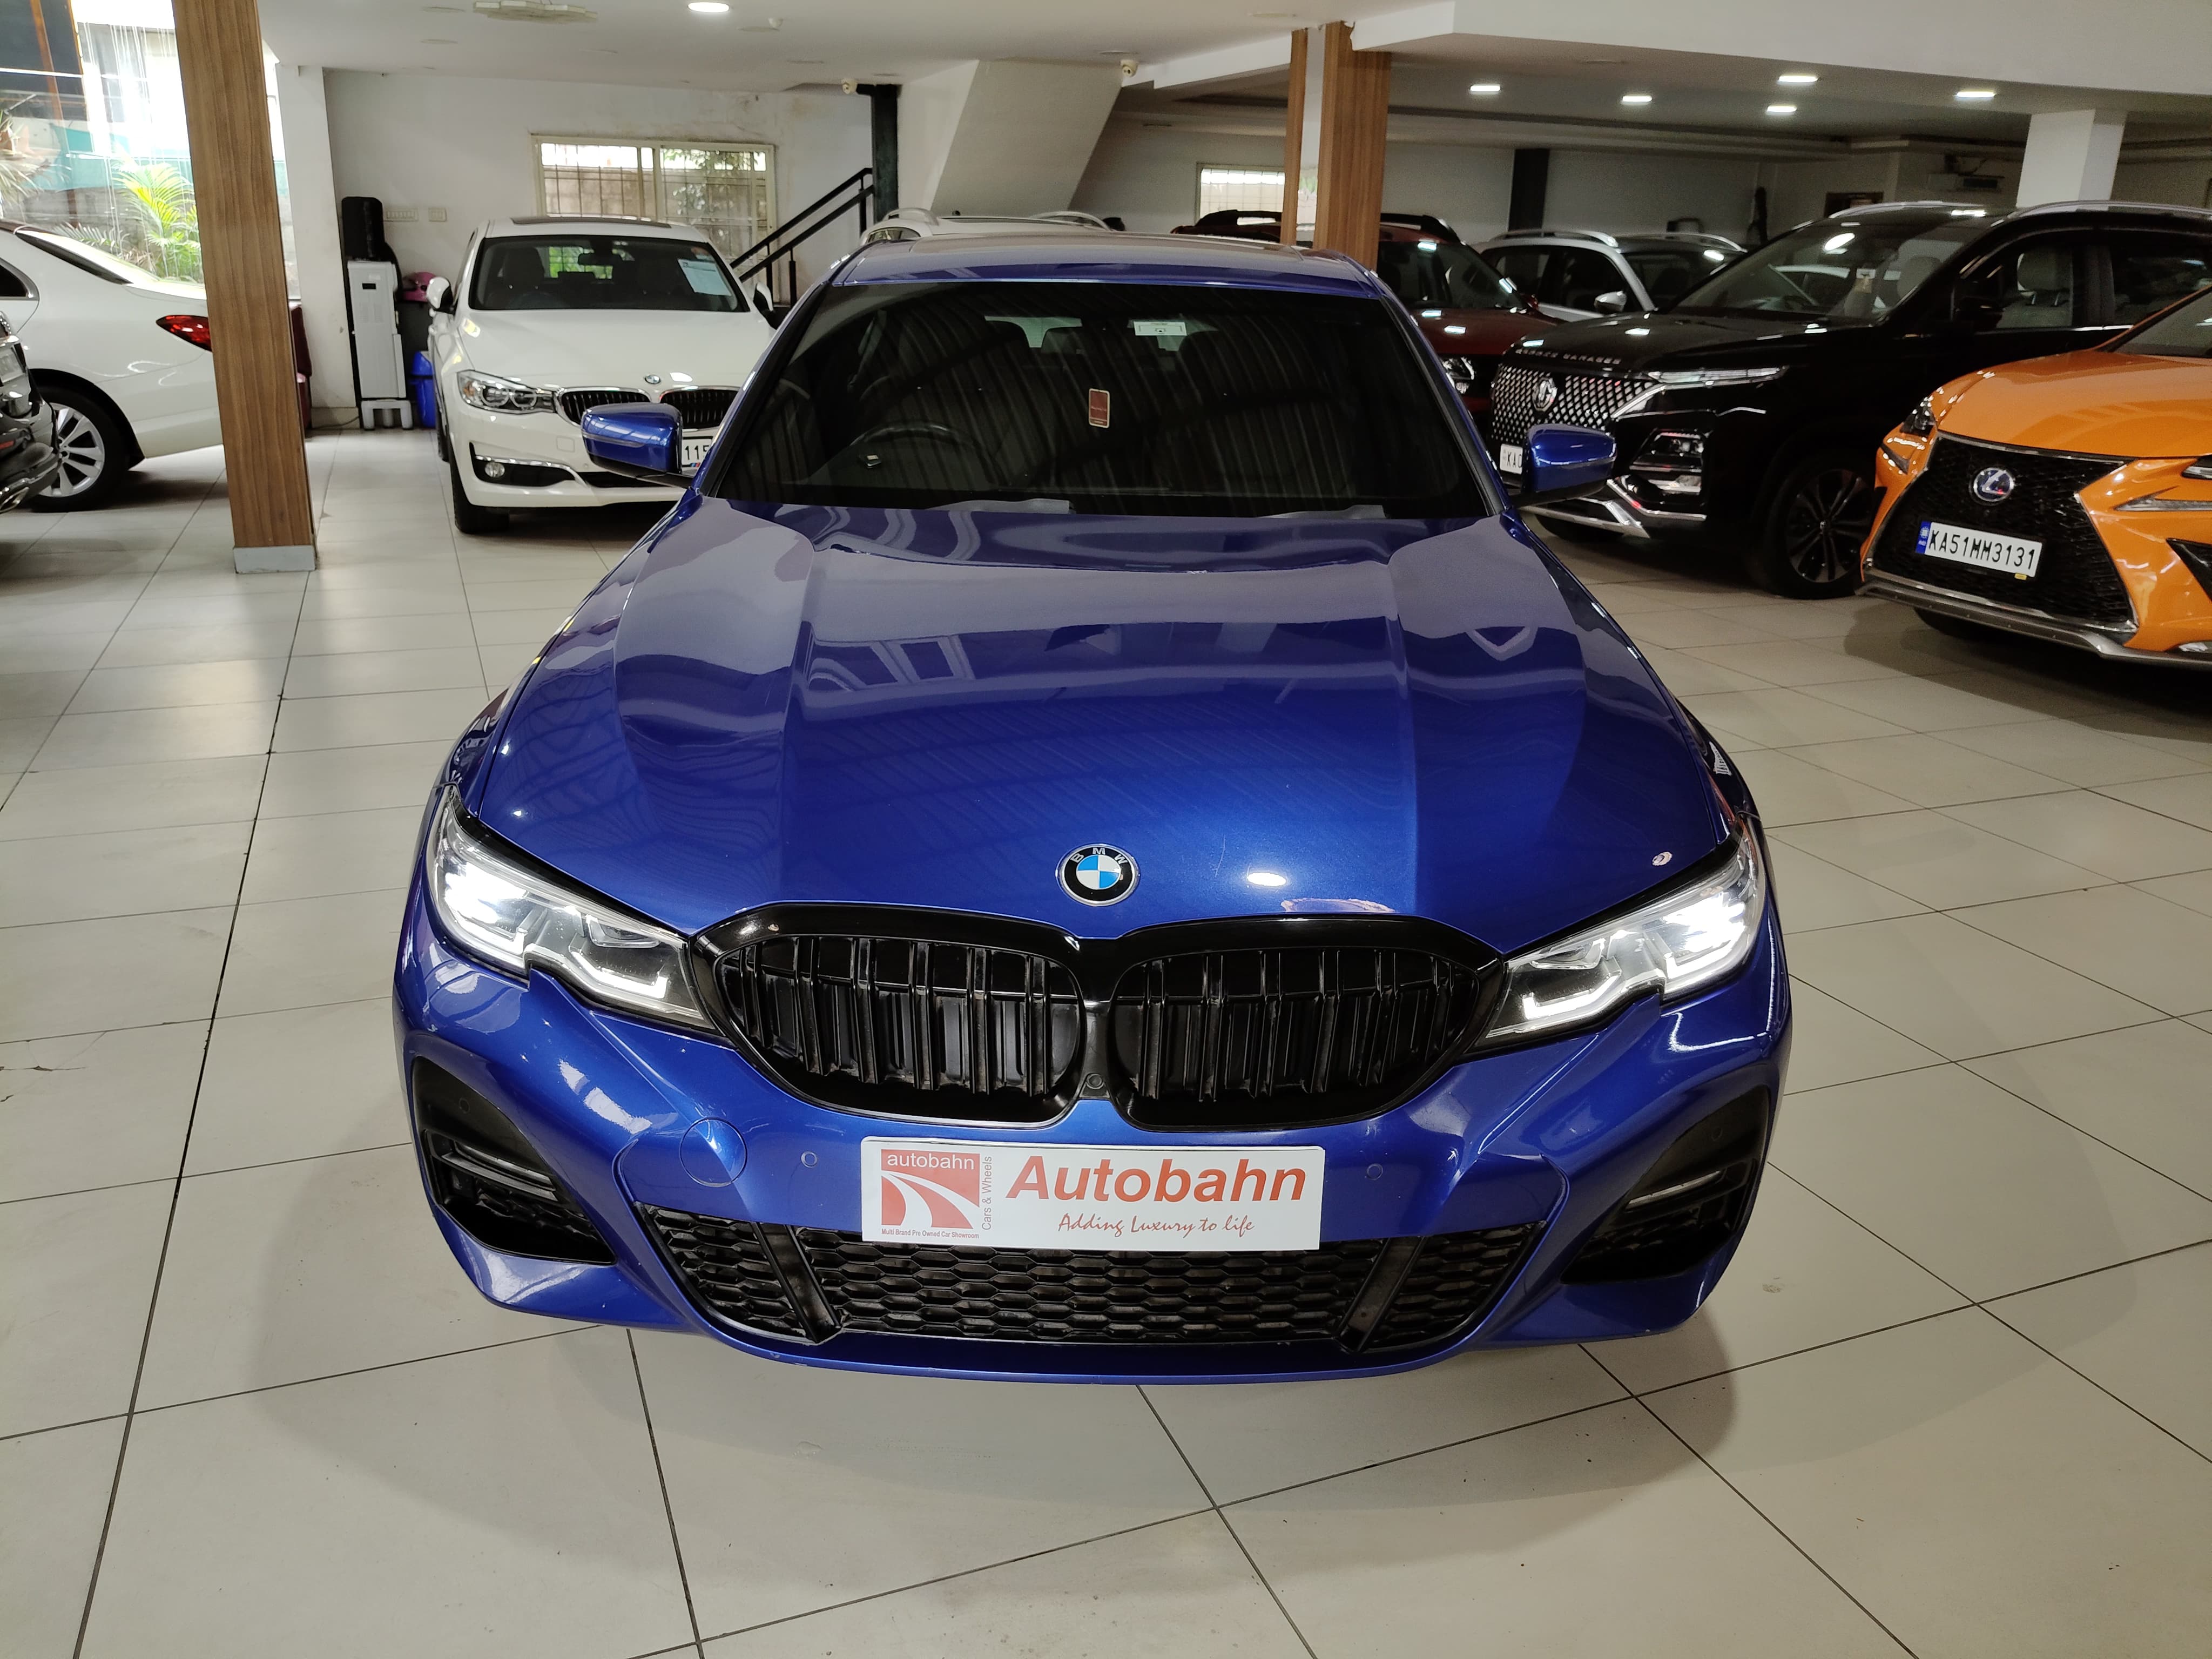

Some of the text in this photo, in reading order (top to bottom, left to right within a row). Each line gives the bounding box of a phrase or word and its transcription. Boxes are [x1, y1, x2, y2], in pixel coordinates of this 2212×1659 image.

[1928, 529, 2035, 570] KA51MM3131
[1070, 847, 1128, 865] BMW
[887, 1152, 974, 1170] autobahn
[982, 1156, 992, 1194] Wheels
[1005, 1155, 1306, 1202] Autobahn
[982, 1206, 992, 1230] Cars
[1058, 1212, 1255, 1238] Adding Luxury to life
